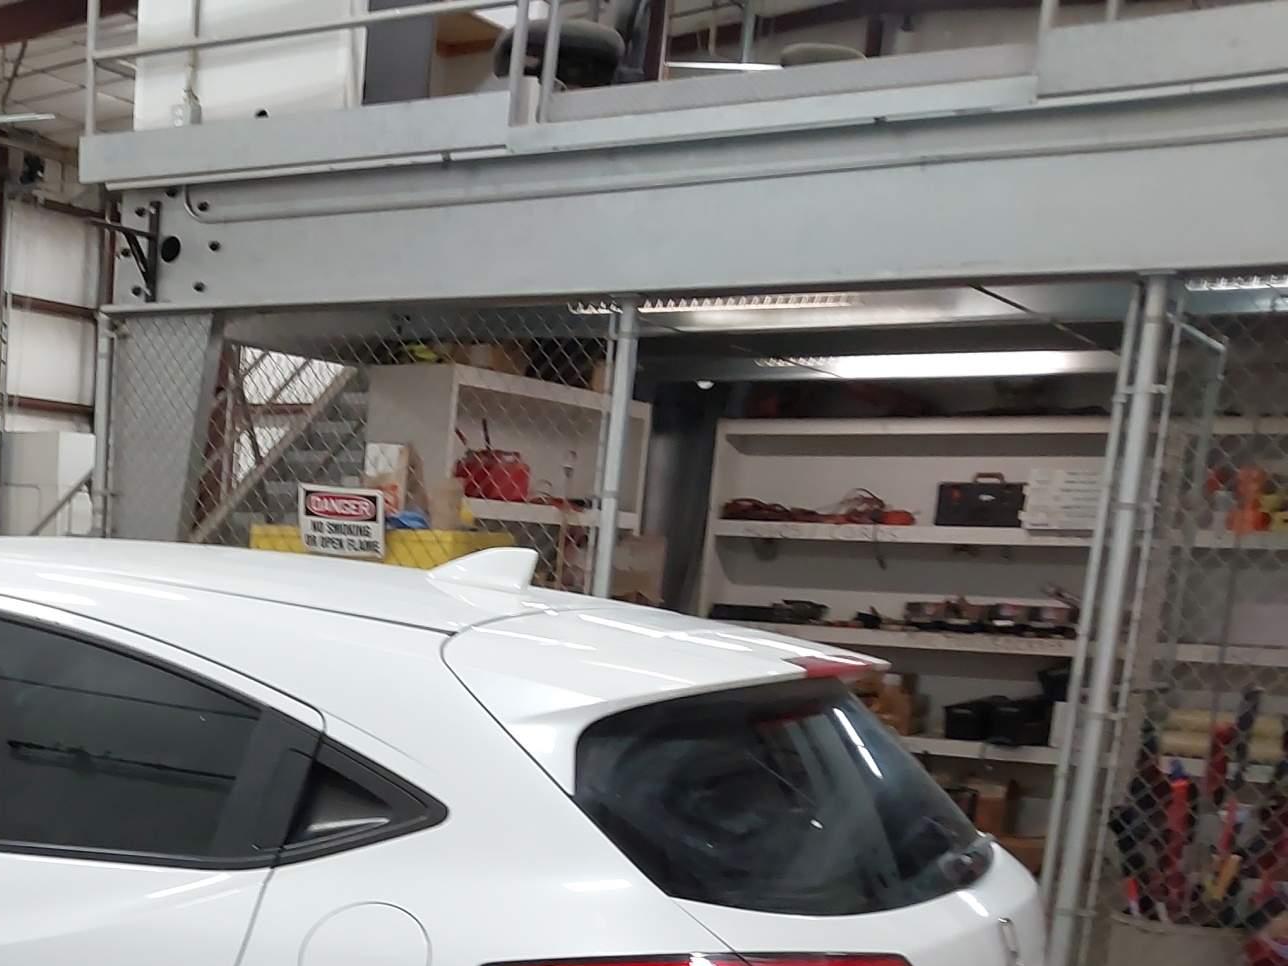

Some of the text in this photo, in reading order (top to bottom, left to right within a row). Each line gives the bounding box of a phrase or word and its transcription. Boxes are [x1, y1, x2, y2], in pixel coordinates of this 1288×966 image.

[310, 494, 372, 516] DANGER
[312, 520, 371, 537] NO SMOKING
[305, 534, 380, 553] OR OPEN FLAME
